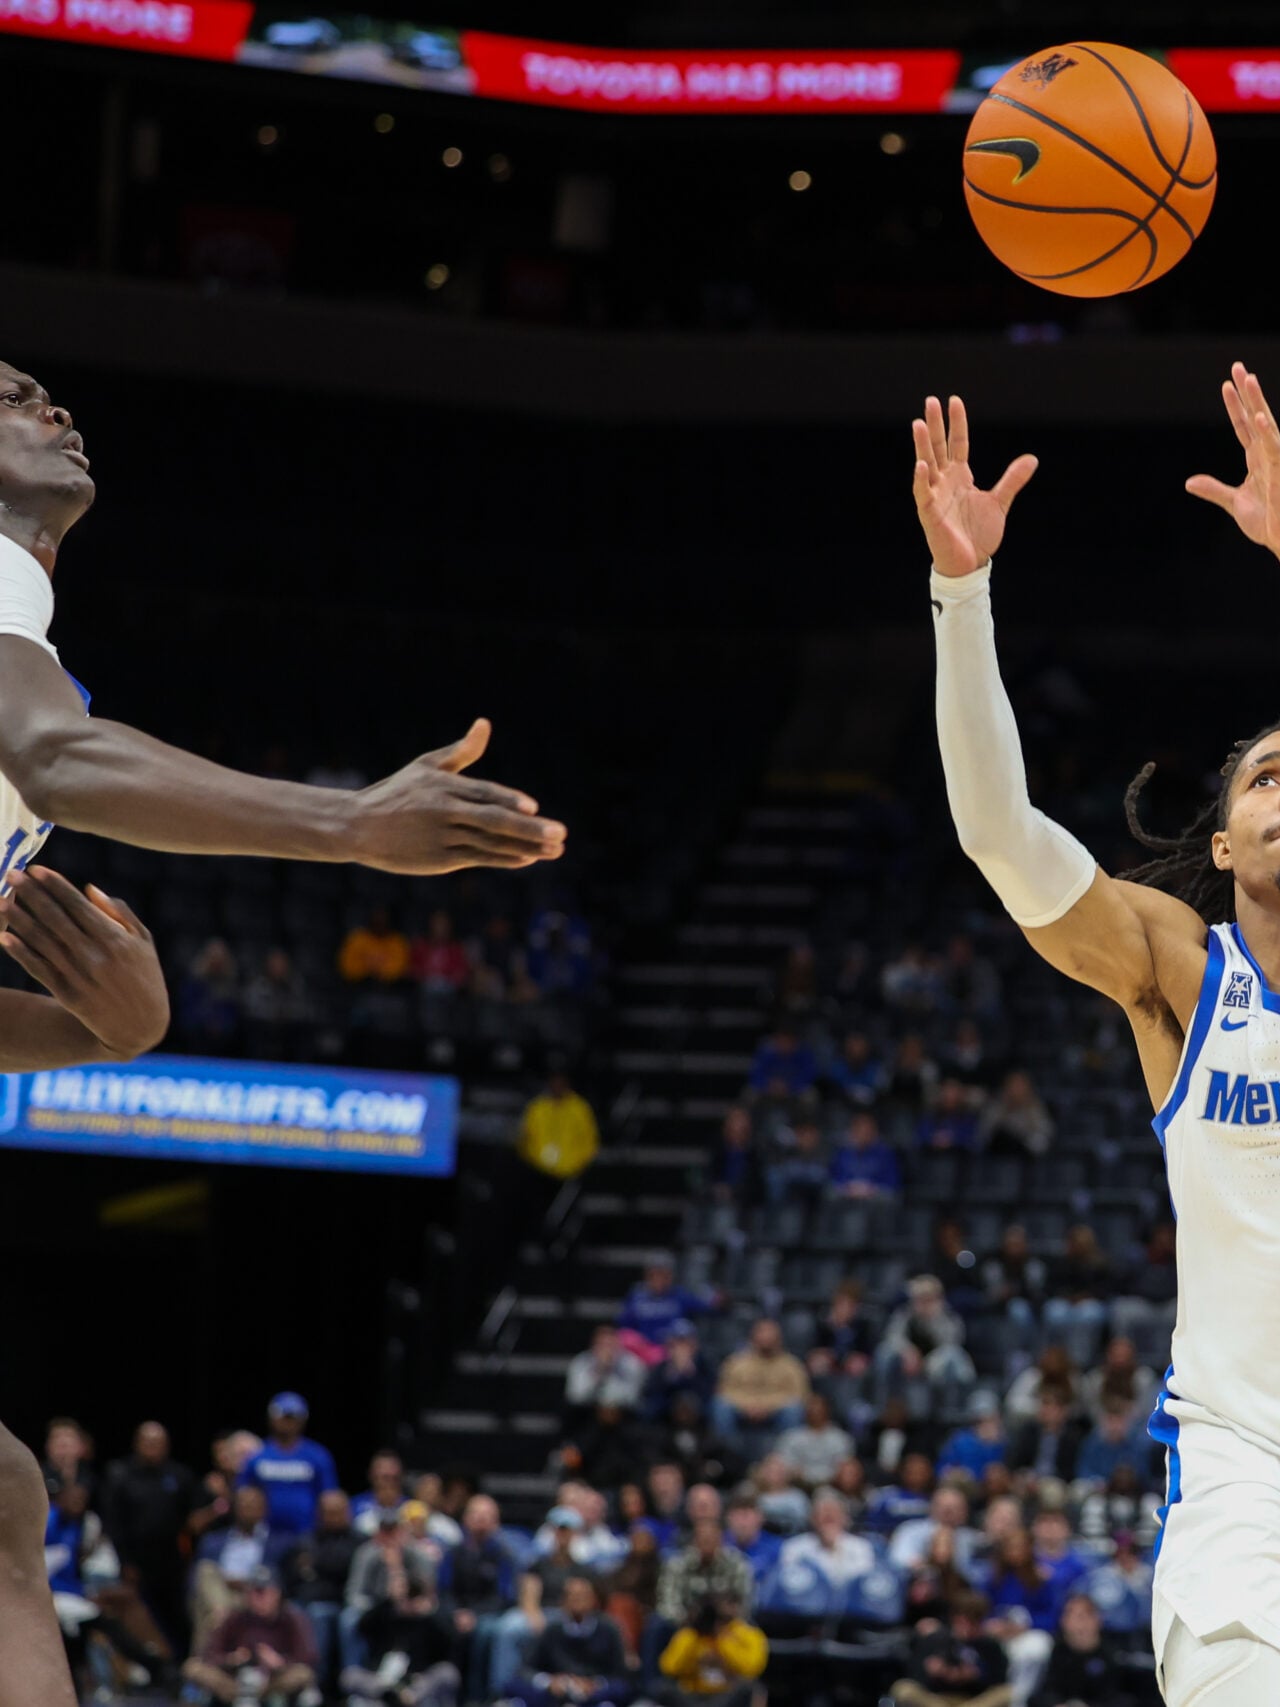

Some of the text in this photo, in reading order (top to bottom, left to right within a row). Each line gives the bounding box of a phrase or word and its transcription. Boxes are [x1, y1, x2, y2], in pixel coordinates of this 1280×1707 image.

[64, 0, 194, 43] MORE
[522, 52, 902, 100] TOYOTA HAS MORE
